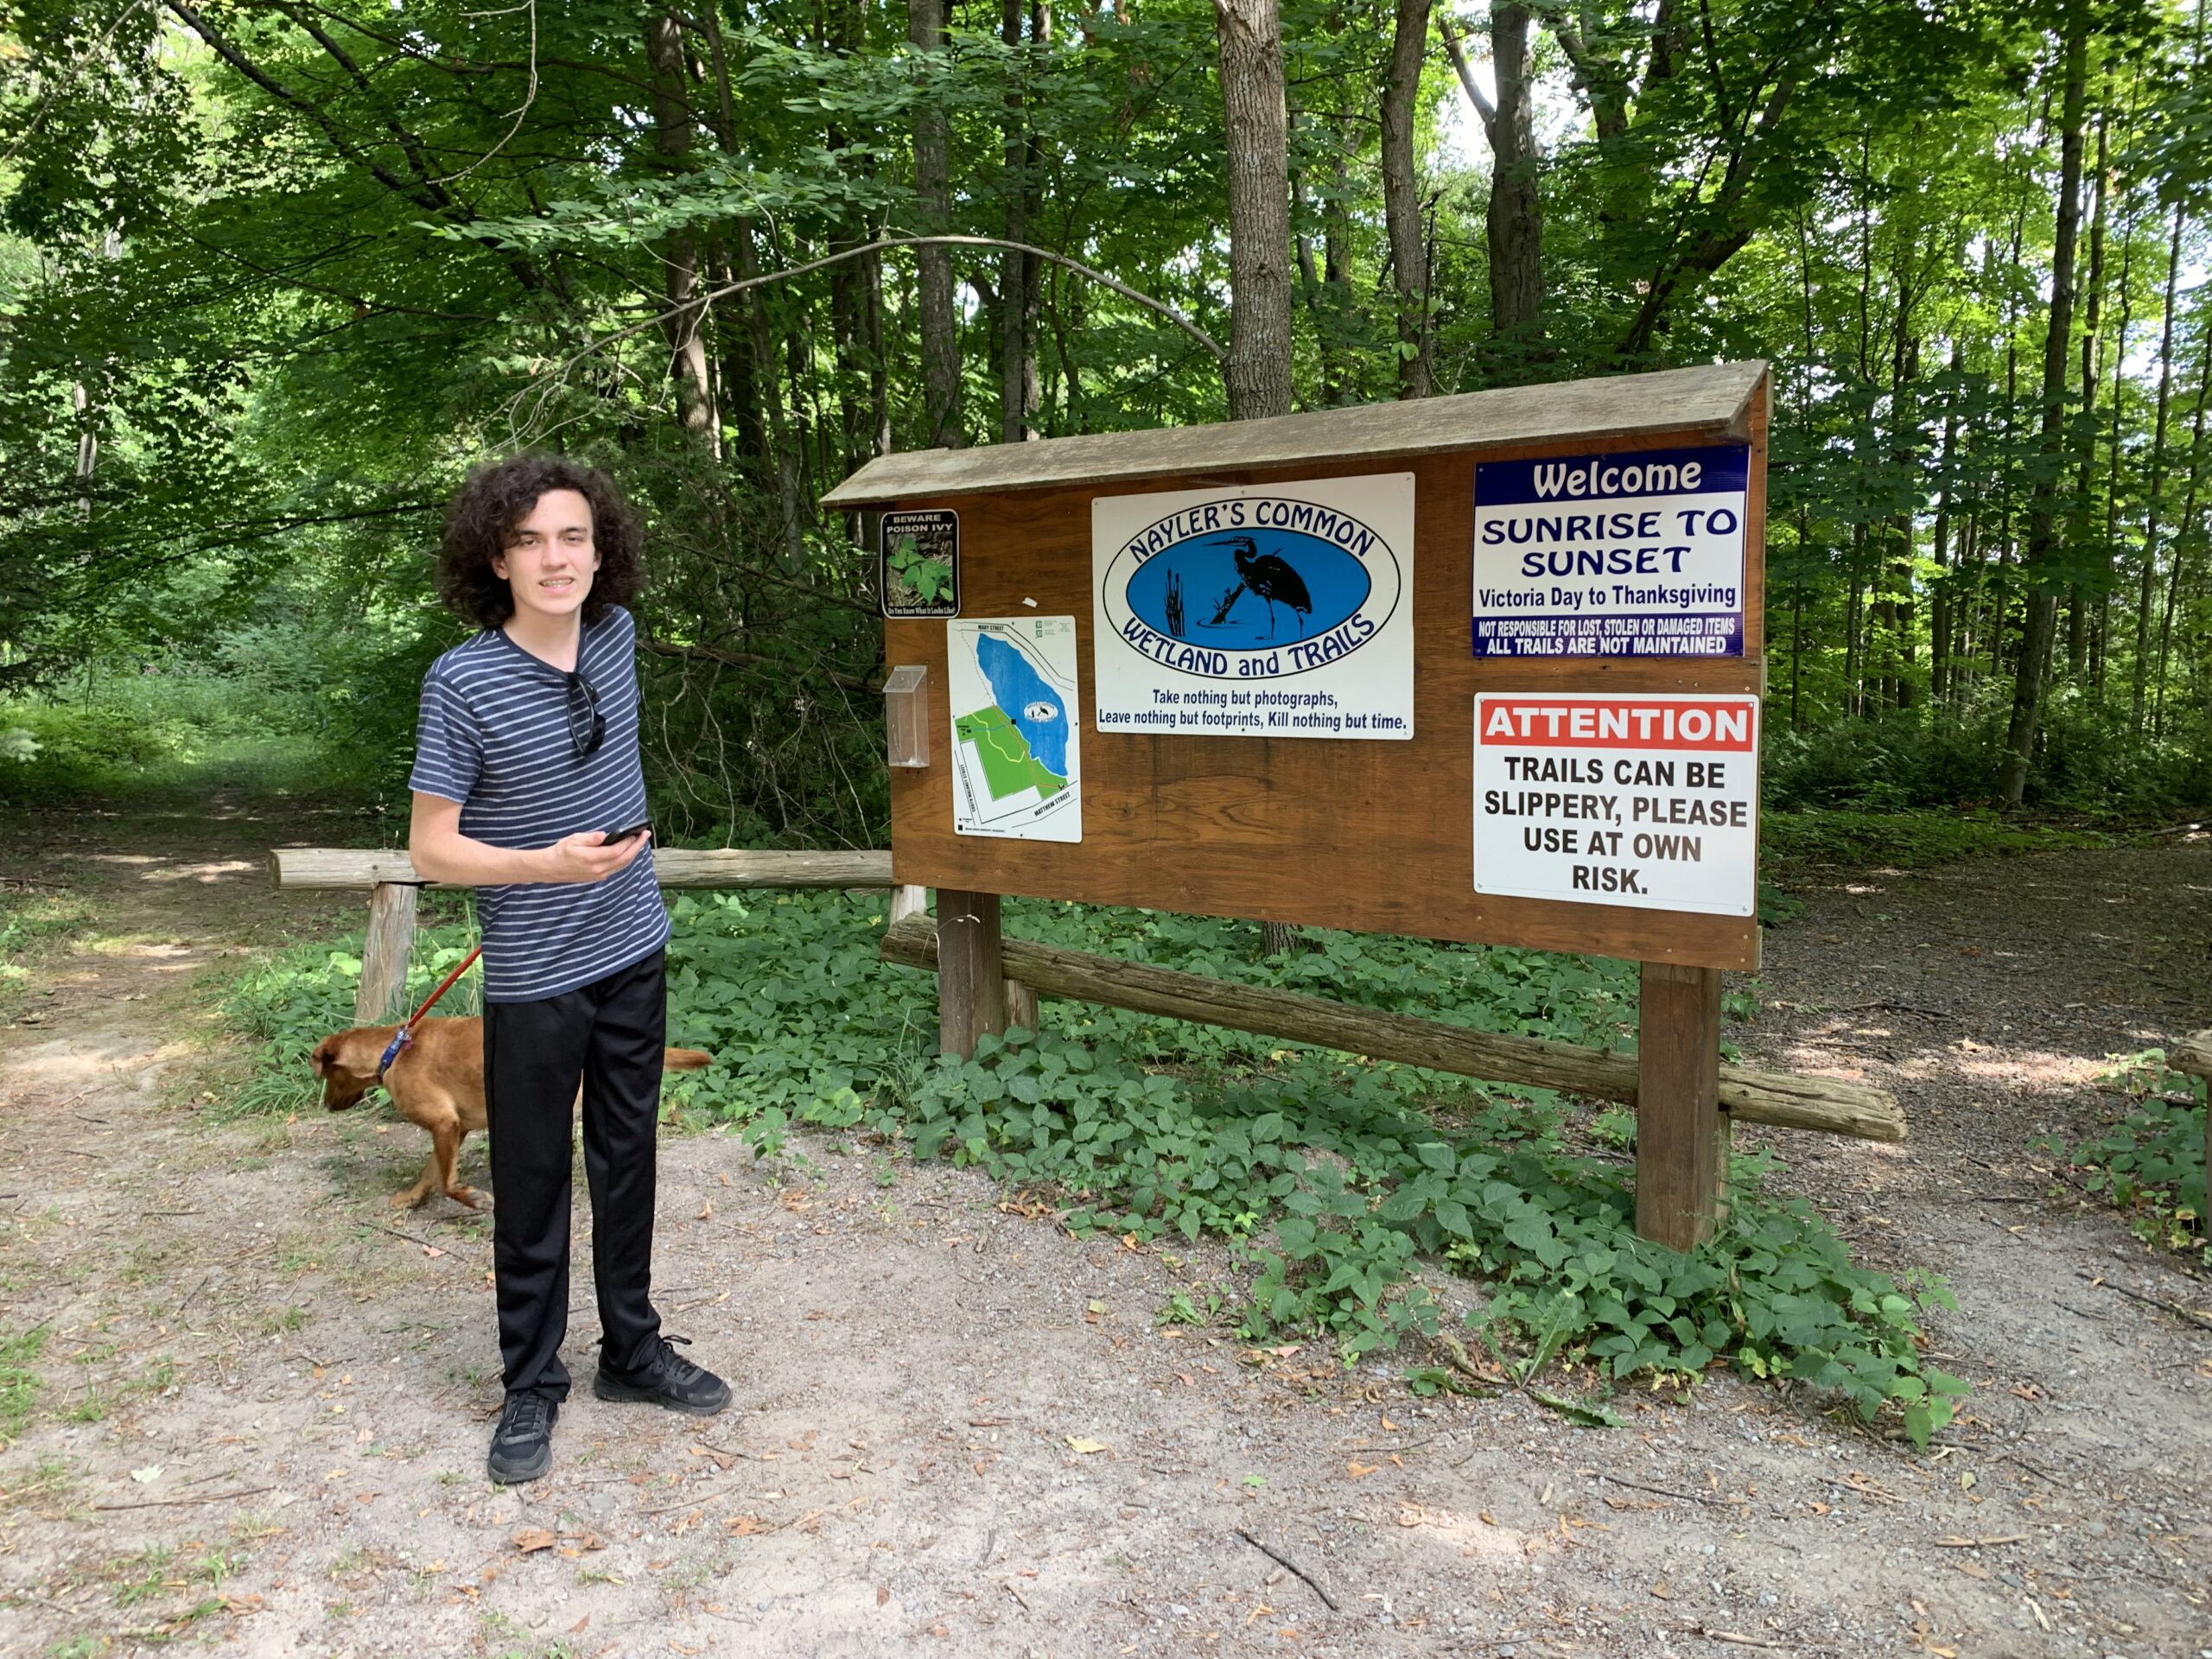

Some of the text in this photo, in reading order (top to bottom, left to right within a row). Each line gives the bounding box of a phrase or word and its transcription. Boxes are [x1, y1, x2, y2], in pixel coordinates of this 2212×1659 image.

[1534, 461, 1701, 498] Welcome
[887, 524, 928, 533] POISON
[893, 514, 941, 524] BEWARE
[1129, 501, 1376, 563] NAYLER'S COMMON
[1482, 508, 1738, 544] SUNRISE TO
[1521, 546, 1691, 577] SUNSET
[1479, 582, 1736, 610] Victoria Day to Thanksgiving
[1478, 618, 1735, 639] NOT RESPONSIBLE FOR LOST, STOLEN OR DAMAGED ITEMS
[1123, 613, 1375, 677] WETLAND and TRAILS
[1486, 637, 1726, 655] ALL TRAILS ARE NOT MAINTAINED
[1153, 689, 1338, 709] Take nothing but photographs,
[1098, 709, 1408, 732] Leave nothing but footprints, Kill nothing but time.
[1485, 707, 1748, 742] ATTENTION
[1504, 756, 1726, 789] TRAILS CAN BE
[1484, 790, 1748, 828] SLIPPERY, PLEASE
[1524, 827, 1701, 862] USE AT OWN
[1573, 865, 1648, 894] RISK.
